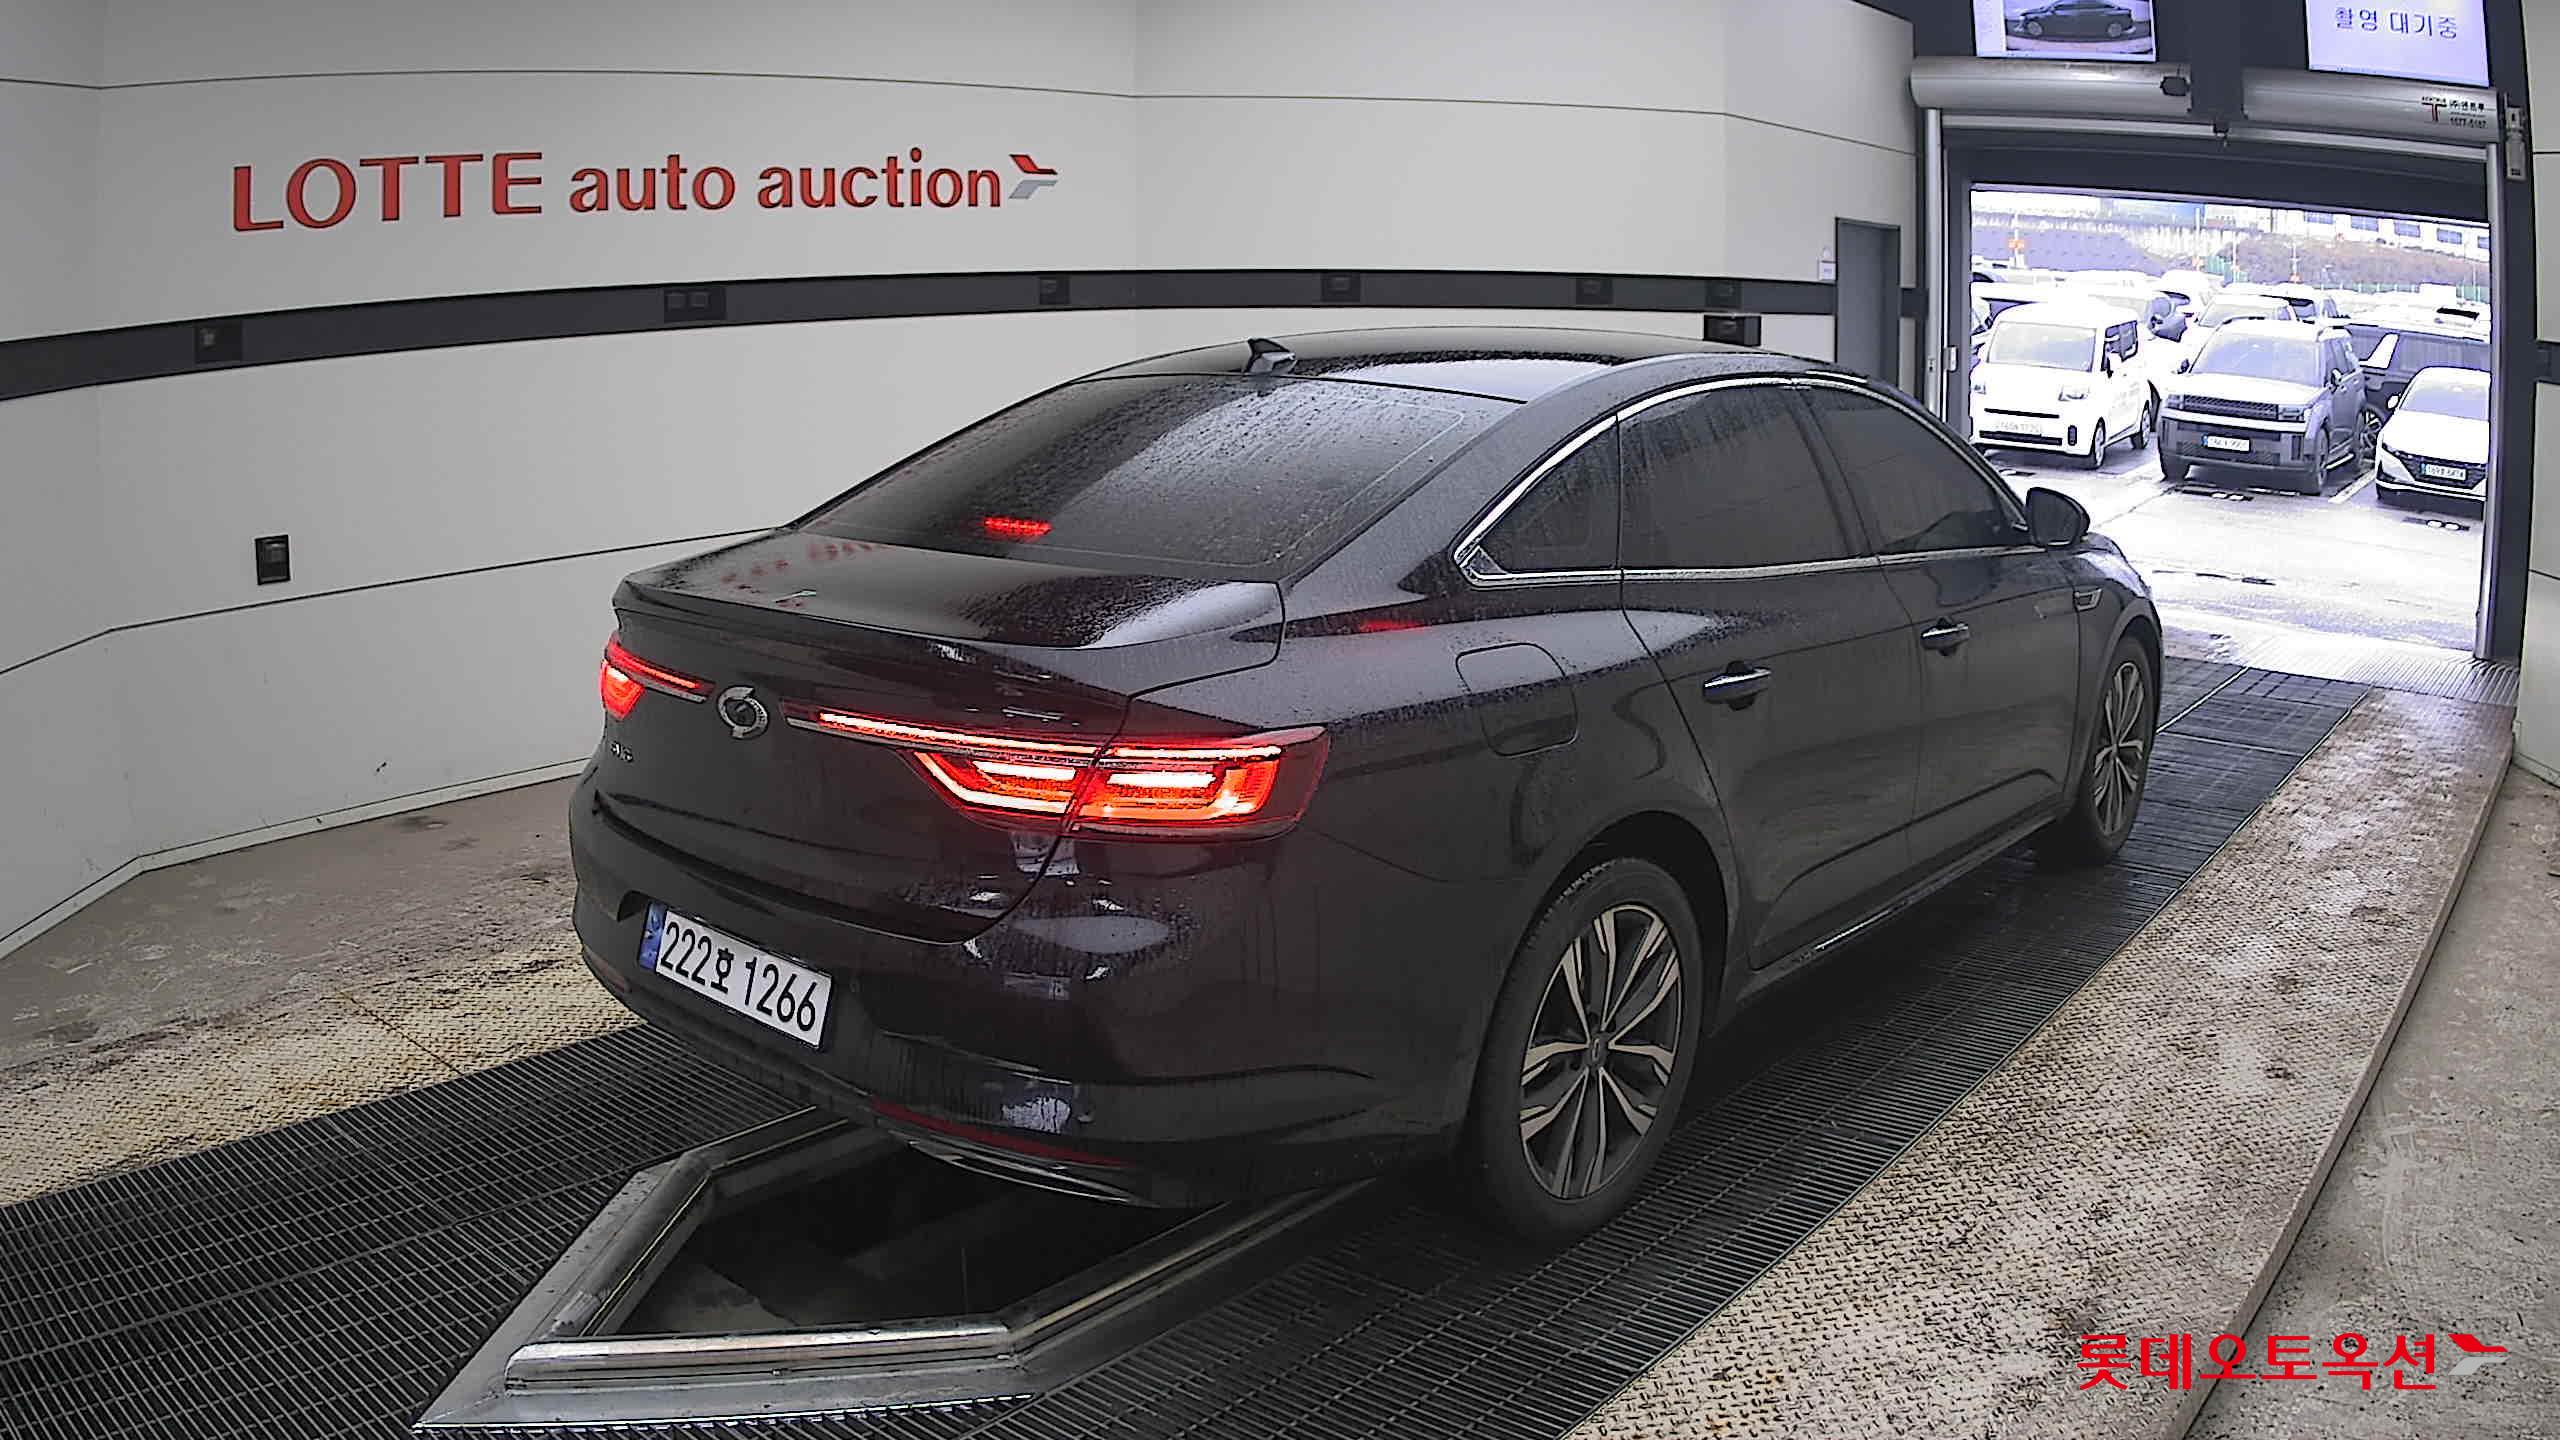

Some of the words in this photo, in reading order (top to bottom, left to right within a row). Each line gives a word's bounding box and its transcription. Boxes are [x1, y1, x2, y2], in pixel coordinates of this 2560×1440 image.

[2335, 7, 2378, 32] 촬영
[2390, 12, 2457, 39] 대기중
[234, 151, 543, 232] LOTTE
[568, 153, 736, 214] auto
[756, 146, 1002, 209] auction
[660, 920, 735, 995] 222호
[744, 956, 818, 1032] 1266
